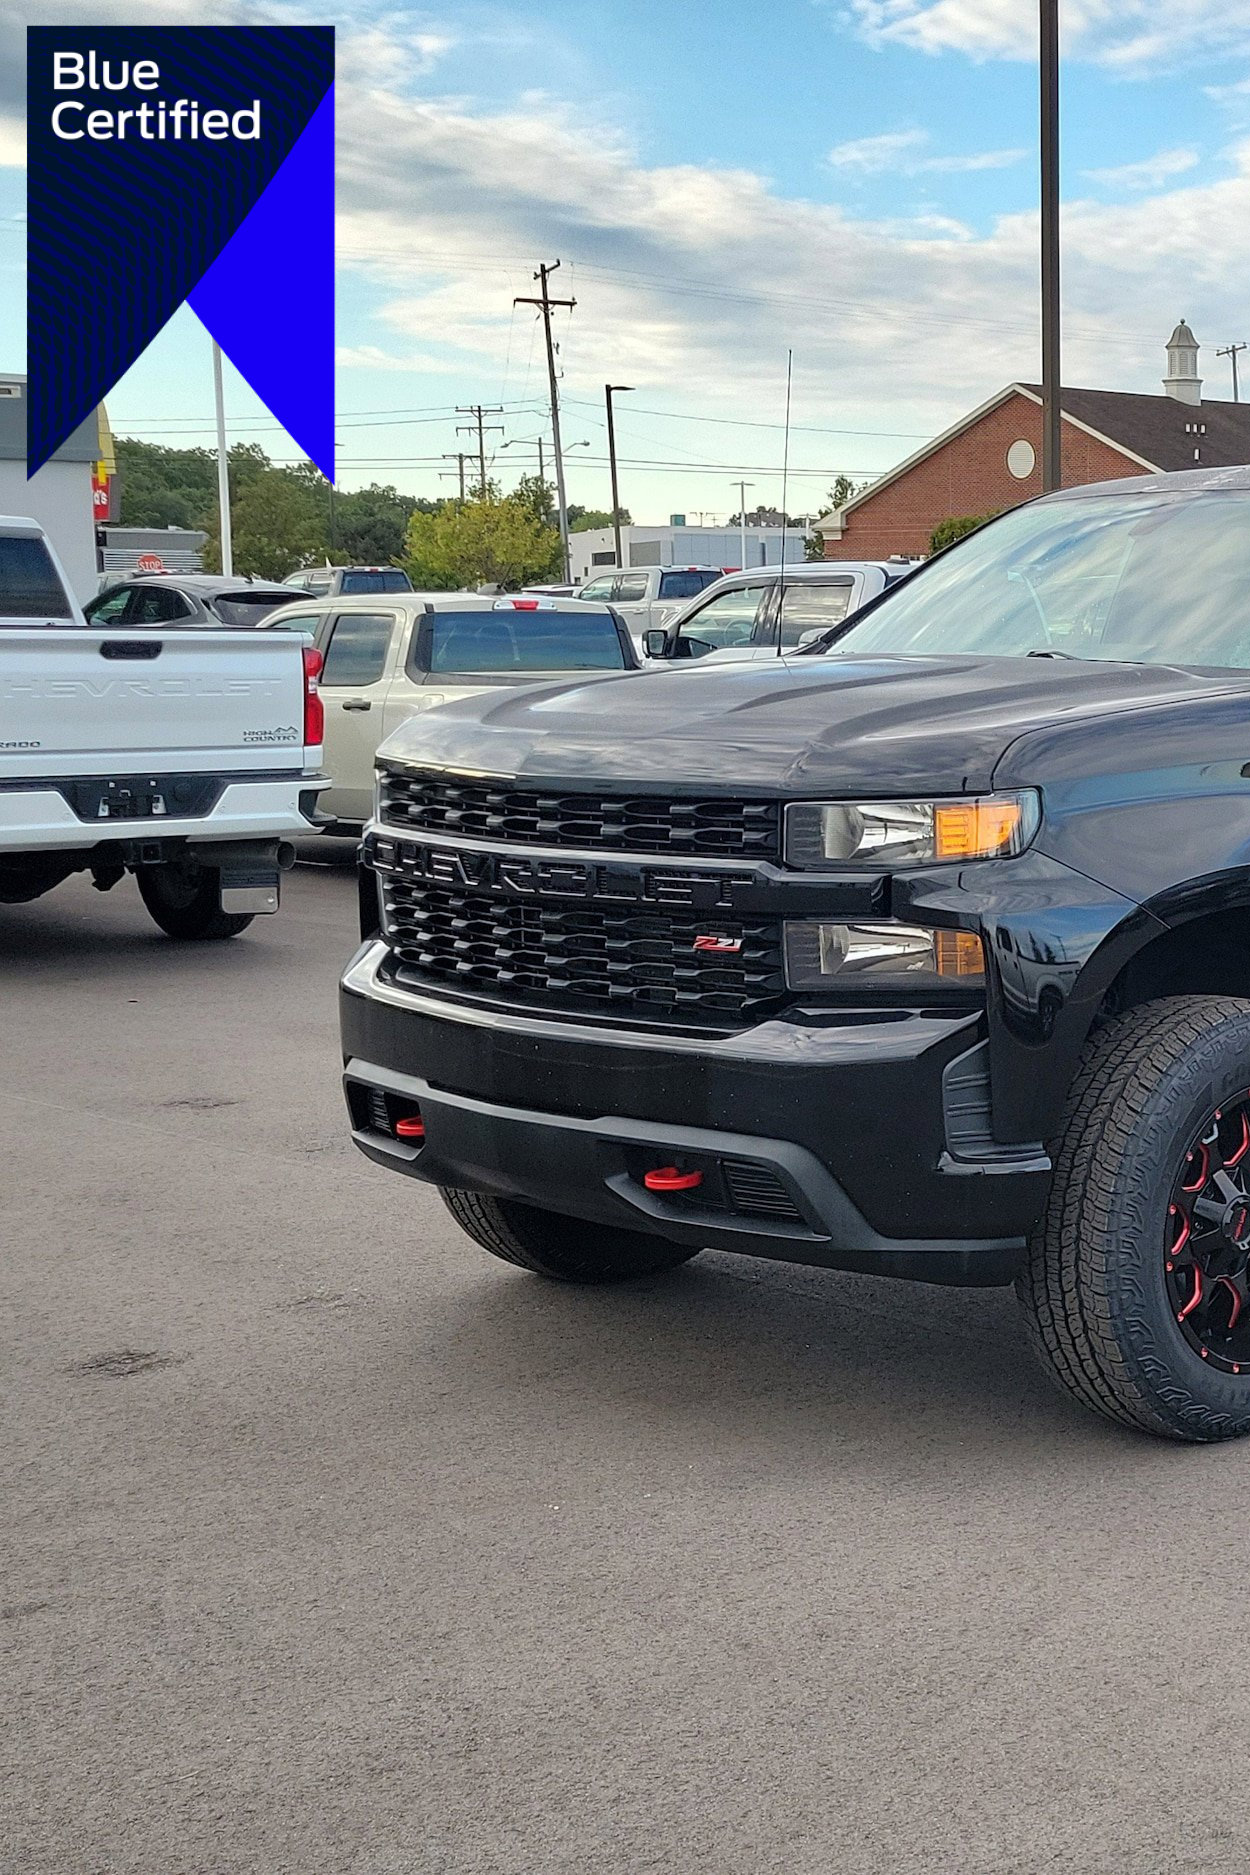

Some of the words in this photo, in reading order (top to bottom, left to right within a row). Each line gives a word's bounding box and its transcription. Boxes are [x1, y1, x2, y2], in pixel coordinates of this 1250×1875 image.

[140, 560, 161, 570] STOP
[243, 735, 297, 743] COUNTRY
[371, 839, 754, 908] CHEVROLET
[692, 935, 744, 952] Z71
